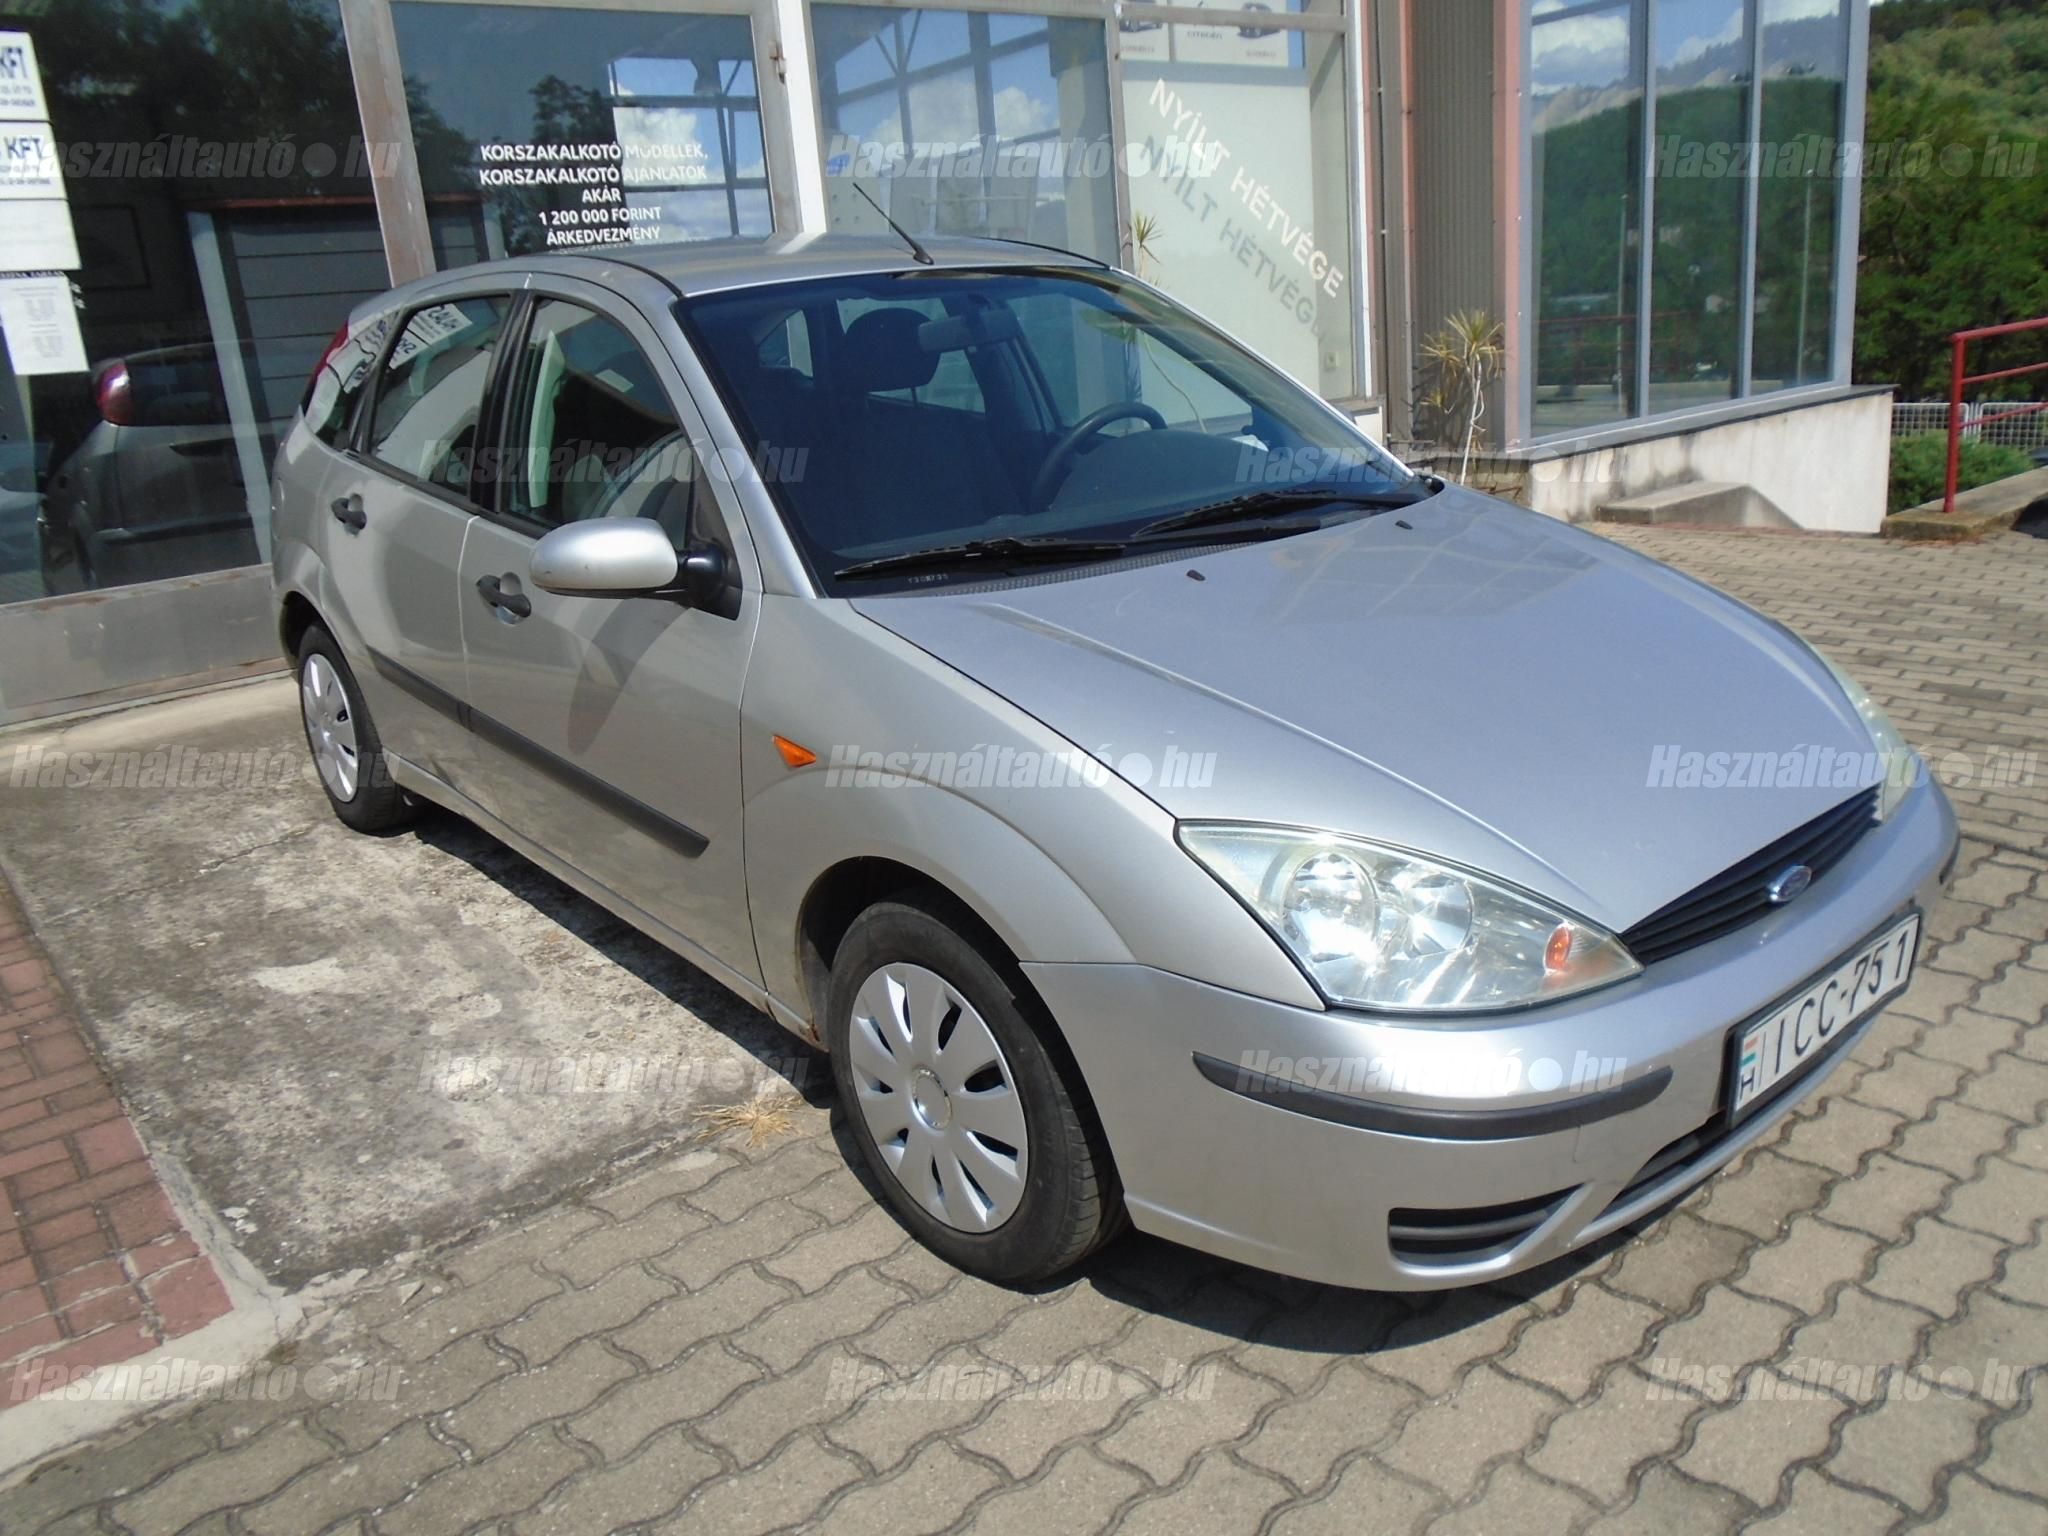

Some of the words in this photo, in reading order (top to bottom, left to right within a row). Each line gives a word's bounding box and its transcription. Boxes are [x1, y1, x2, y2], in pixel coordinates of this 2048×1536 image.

[480, 141, 622, 162] KORSZAKALKOTÓ
[479, 164, 620, 186] KORSZAKALKOTÓ
[582, 185, 622, 204] AKÁR
[538, 211, 547, 226] 1
[551, 209, 580, 226] 200
[581, 208, 609, 224] 000
[611, 206, 662, 222] FORINT
[546, 223, 661, 246] ÁRKEDVEZMÉNY
[1230, 165, 1344, 299] HÉTVÉGE
[1774, 929, 1909, 1075] ICC-751
[1739, 1068, 1756, 1100] H
